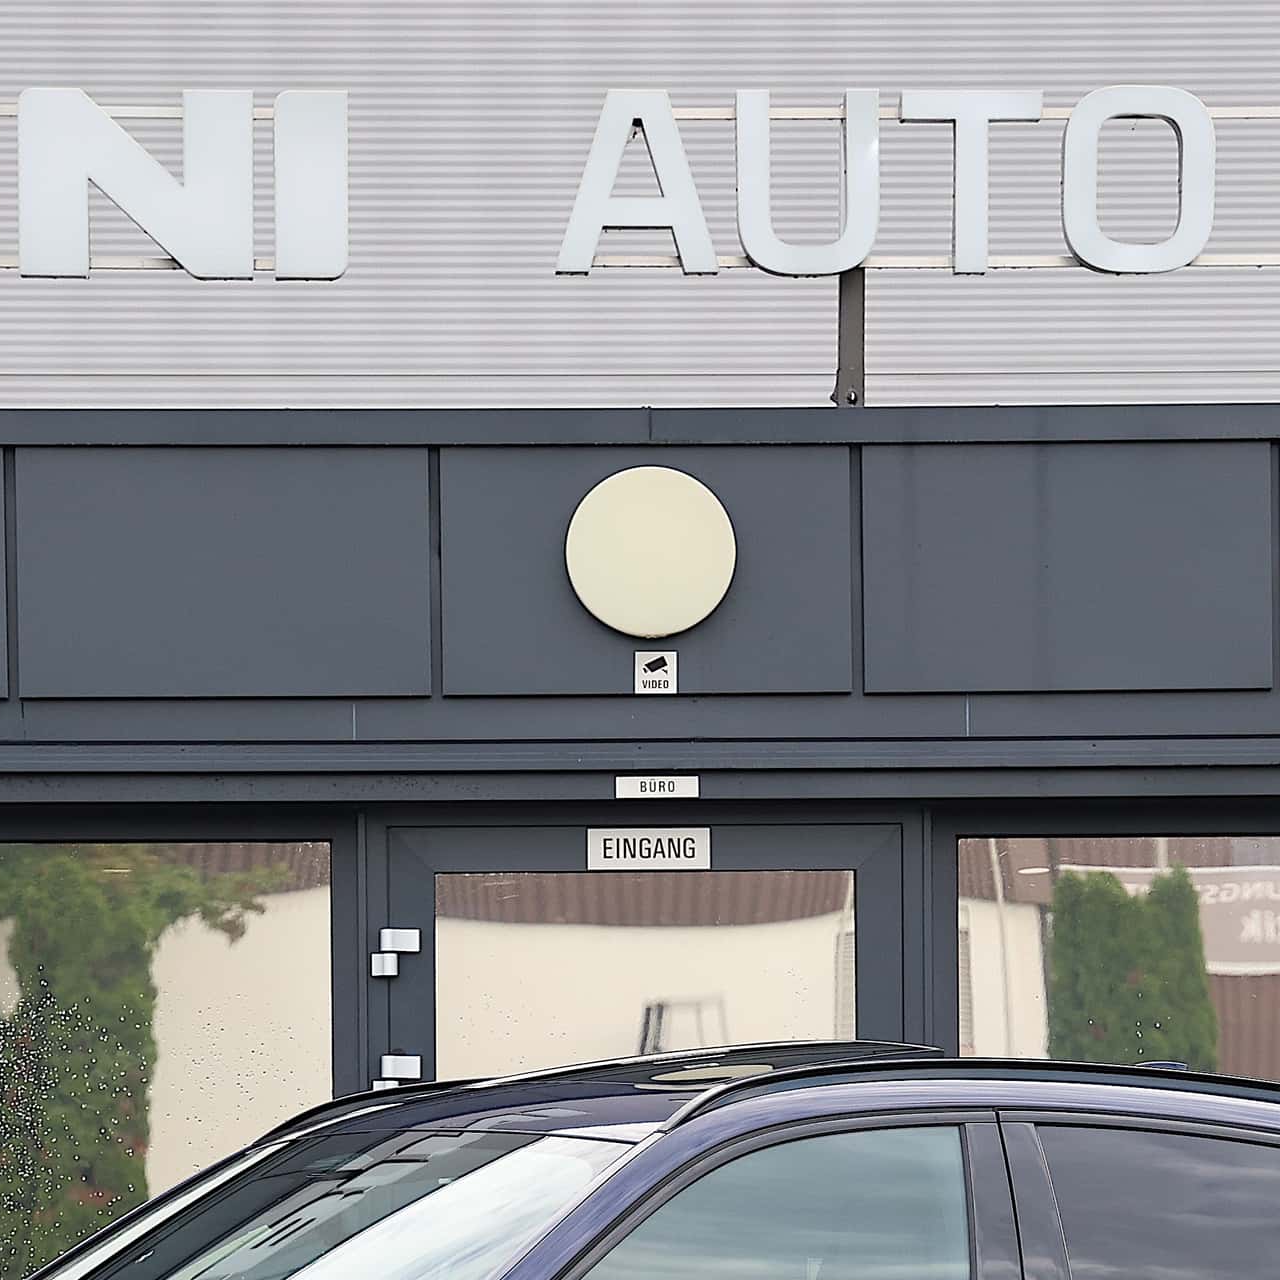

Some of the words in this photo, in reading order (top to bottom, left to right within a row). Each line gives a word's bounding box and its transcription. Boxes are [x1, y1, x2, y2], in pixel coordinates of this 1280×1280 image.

[554, 84, 1217, 277] AUTO
[642, 680, 669, 689] VIDEO
[640, 779, 676, 793] BÜRO
[602, 838, 696, 859] EINGANG
